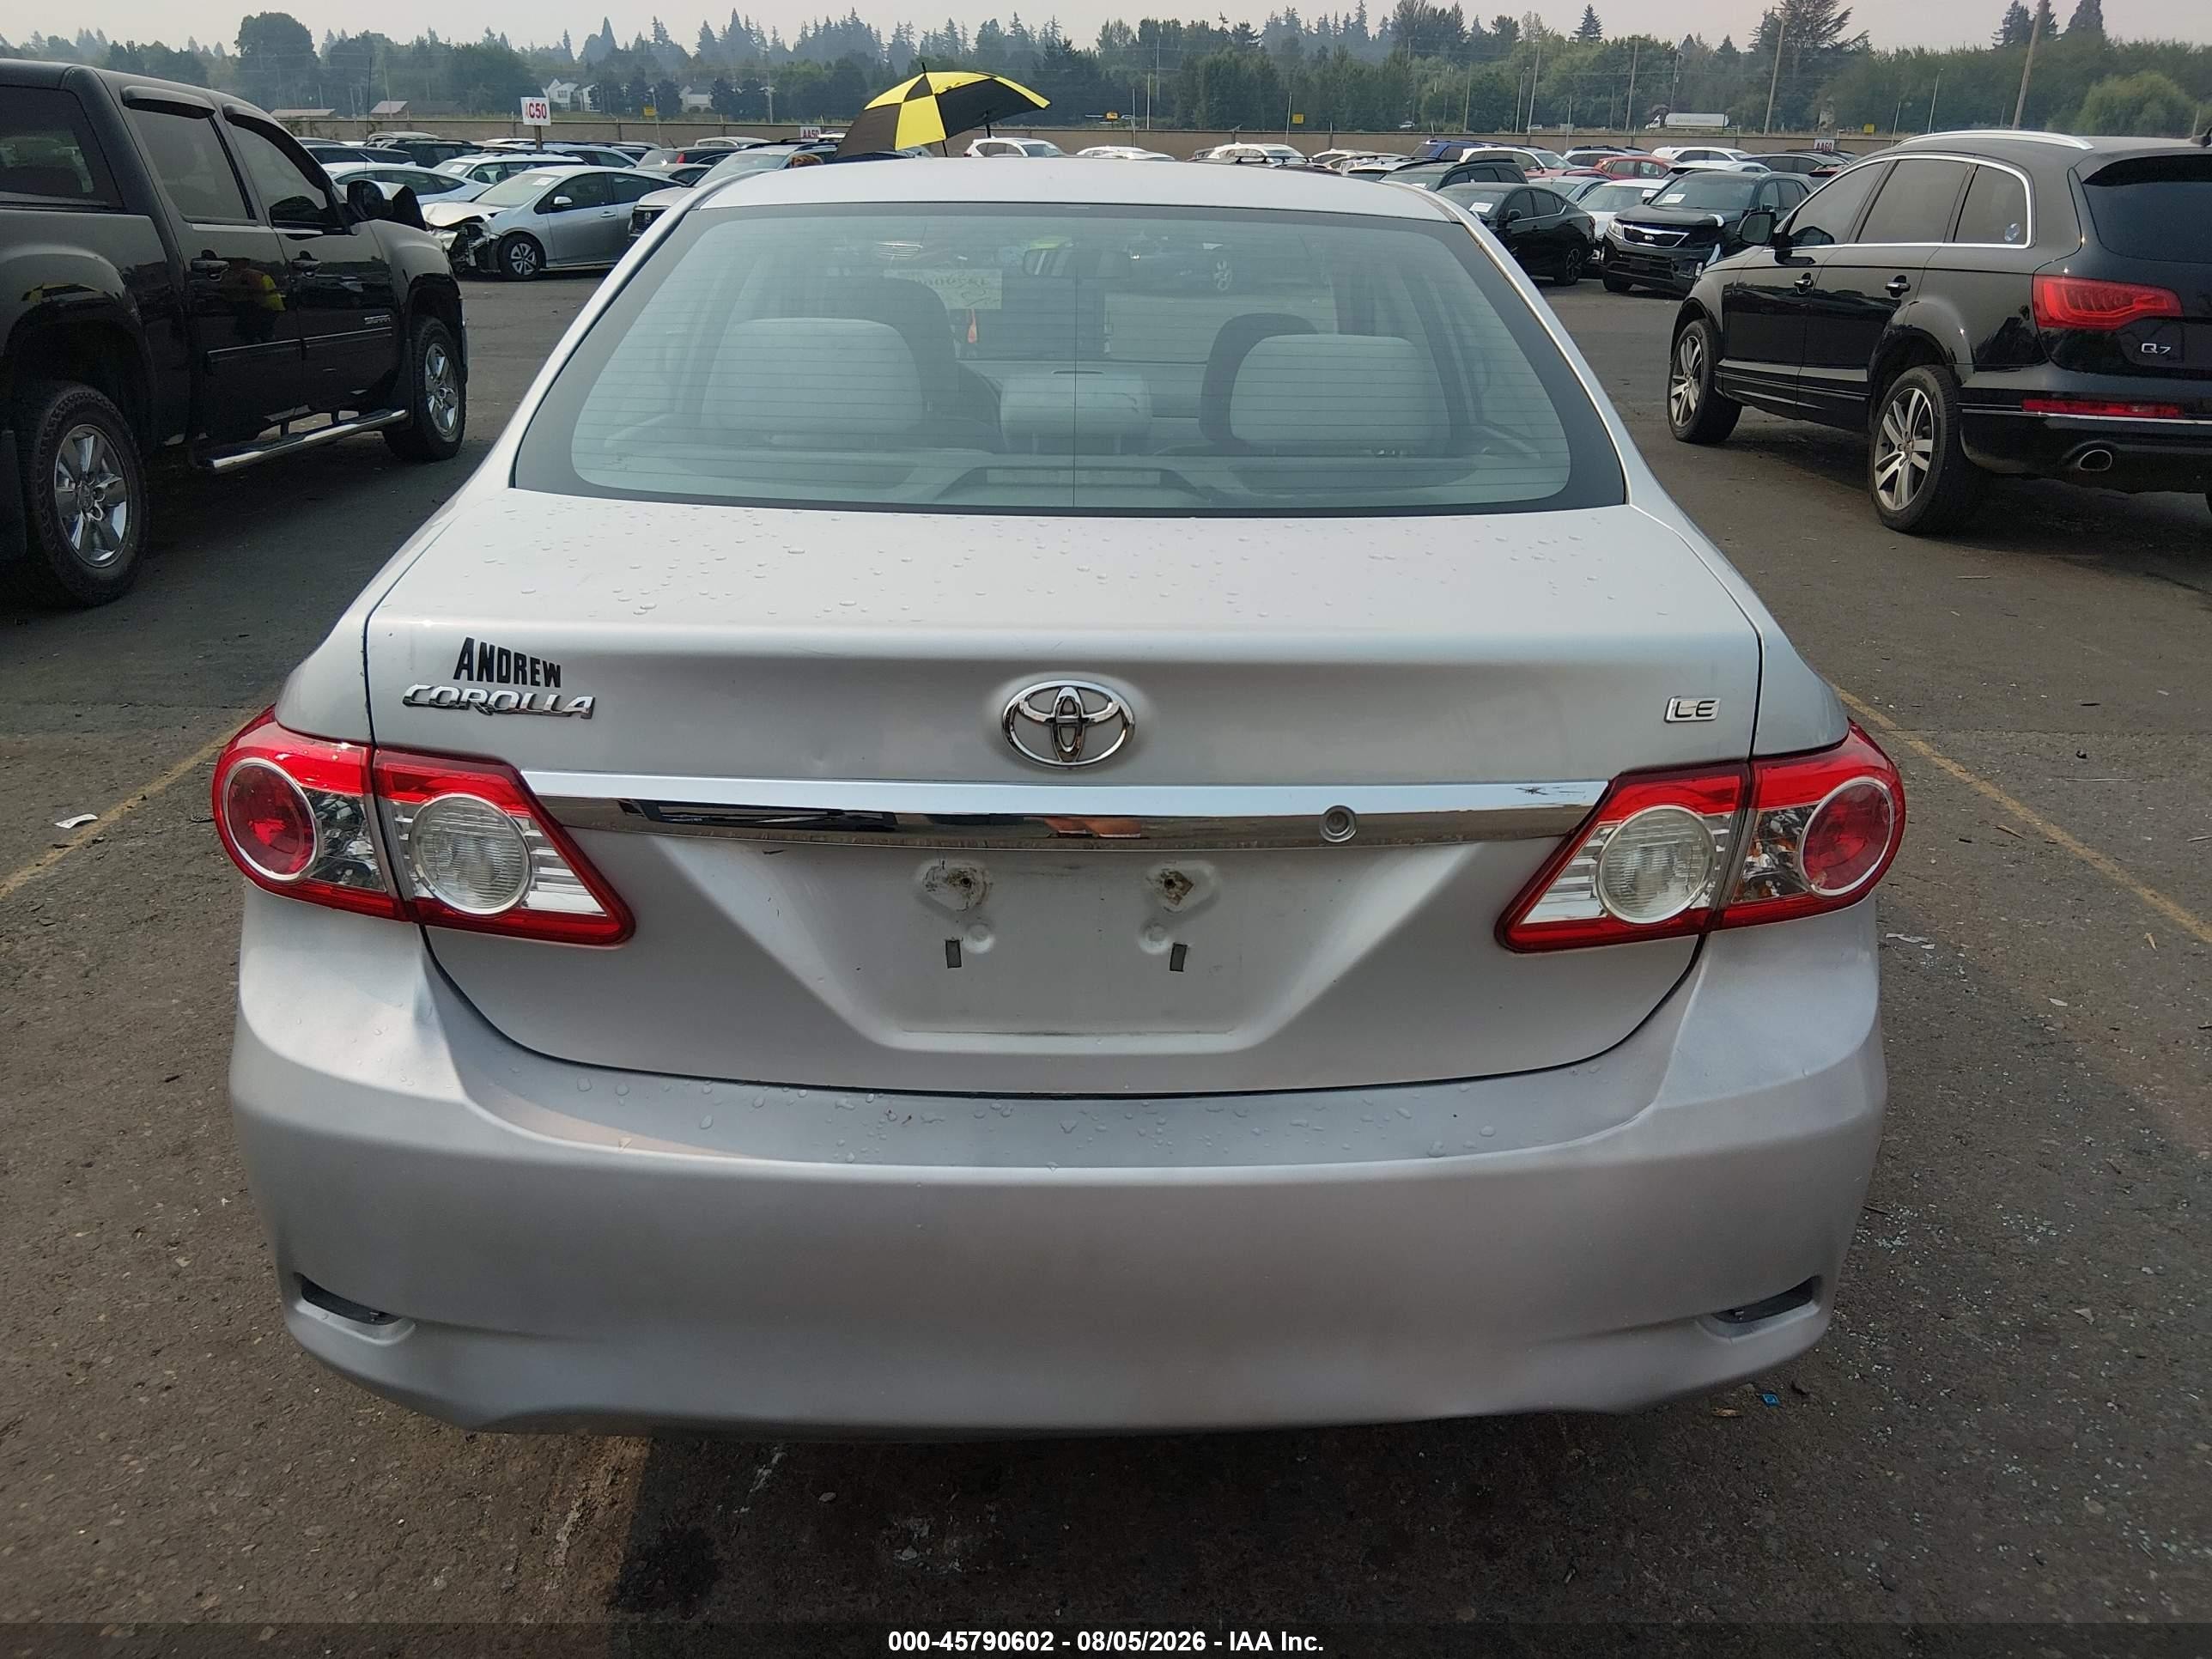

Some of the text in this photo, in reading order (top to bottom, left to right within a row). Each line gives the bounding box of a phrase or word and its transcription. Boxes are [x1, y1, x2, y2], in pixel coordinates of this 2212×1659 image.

[2141, 343, 2172, 355] Q7
[453, 636, 562, 689] ANDREW
[402, 684, 596, 720] COROLLA
